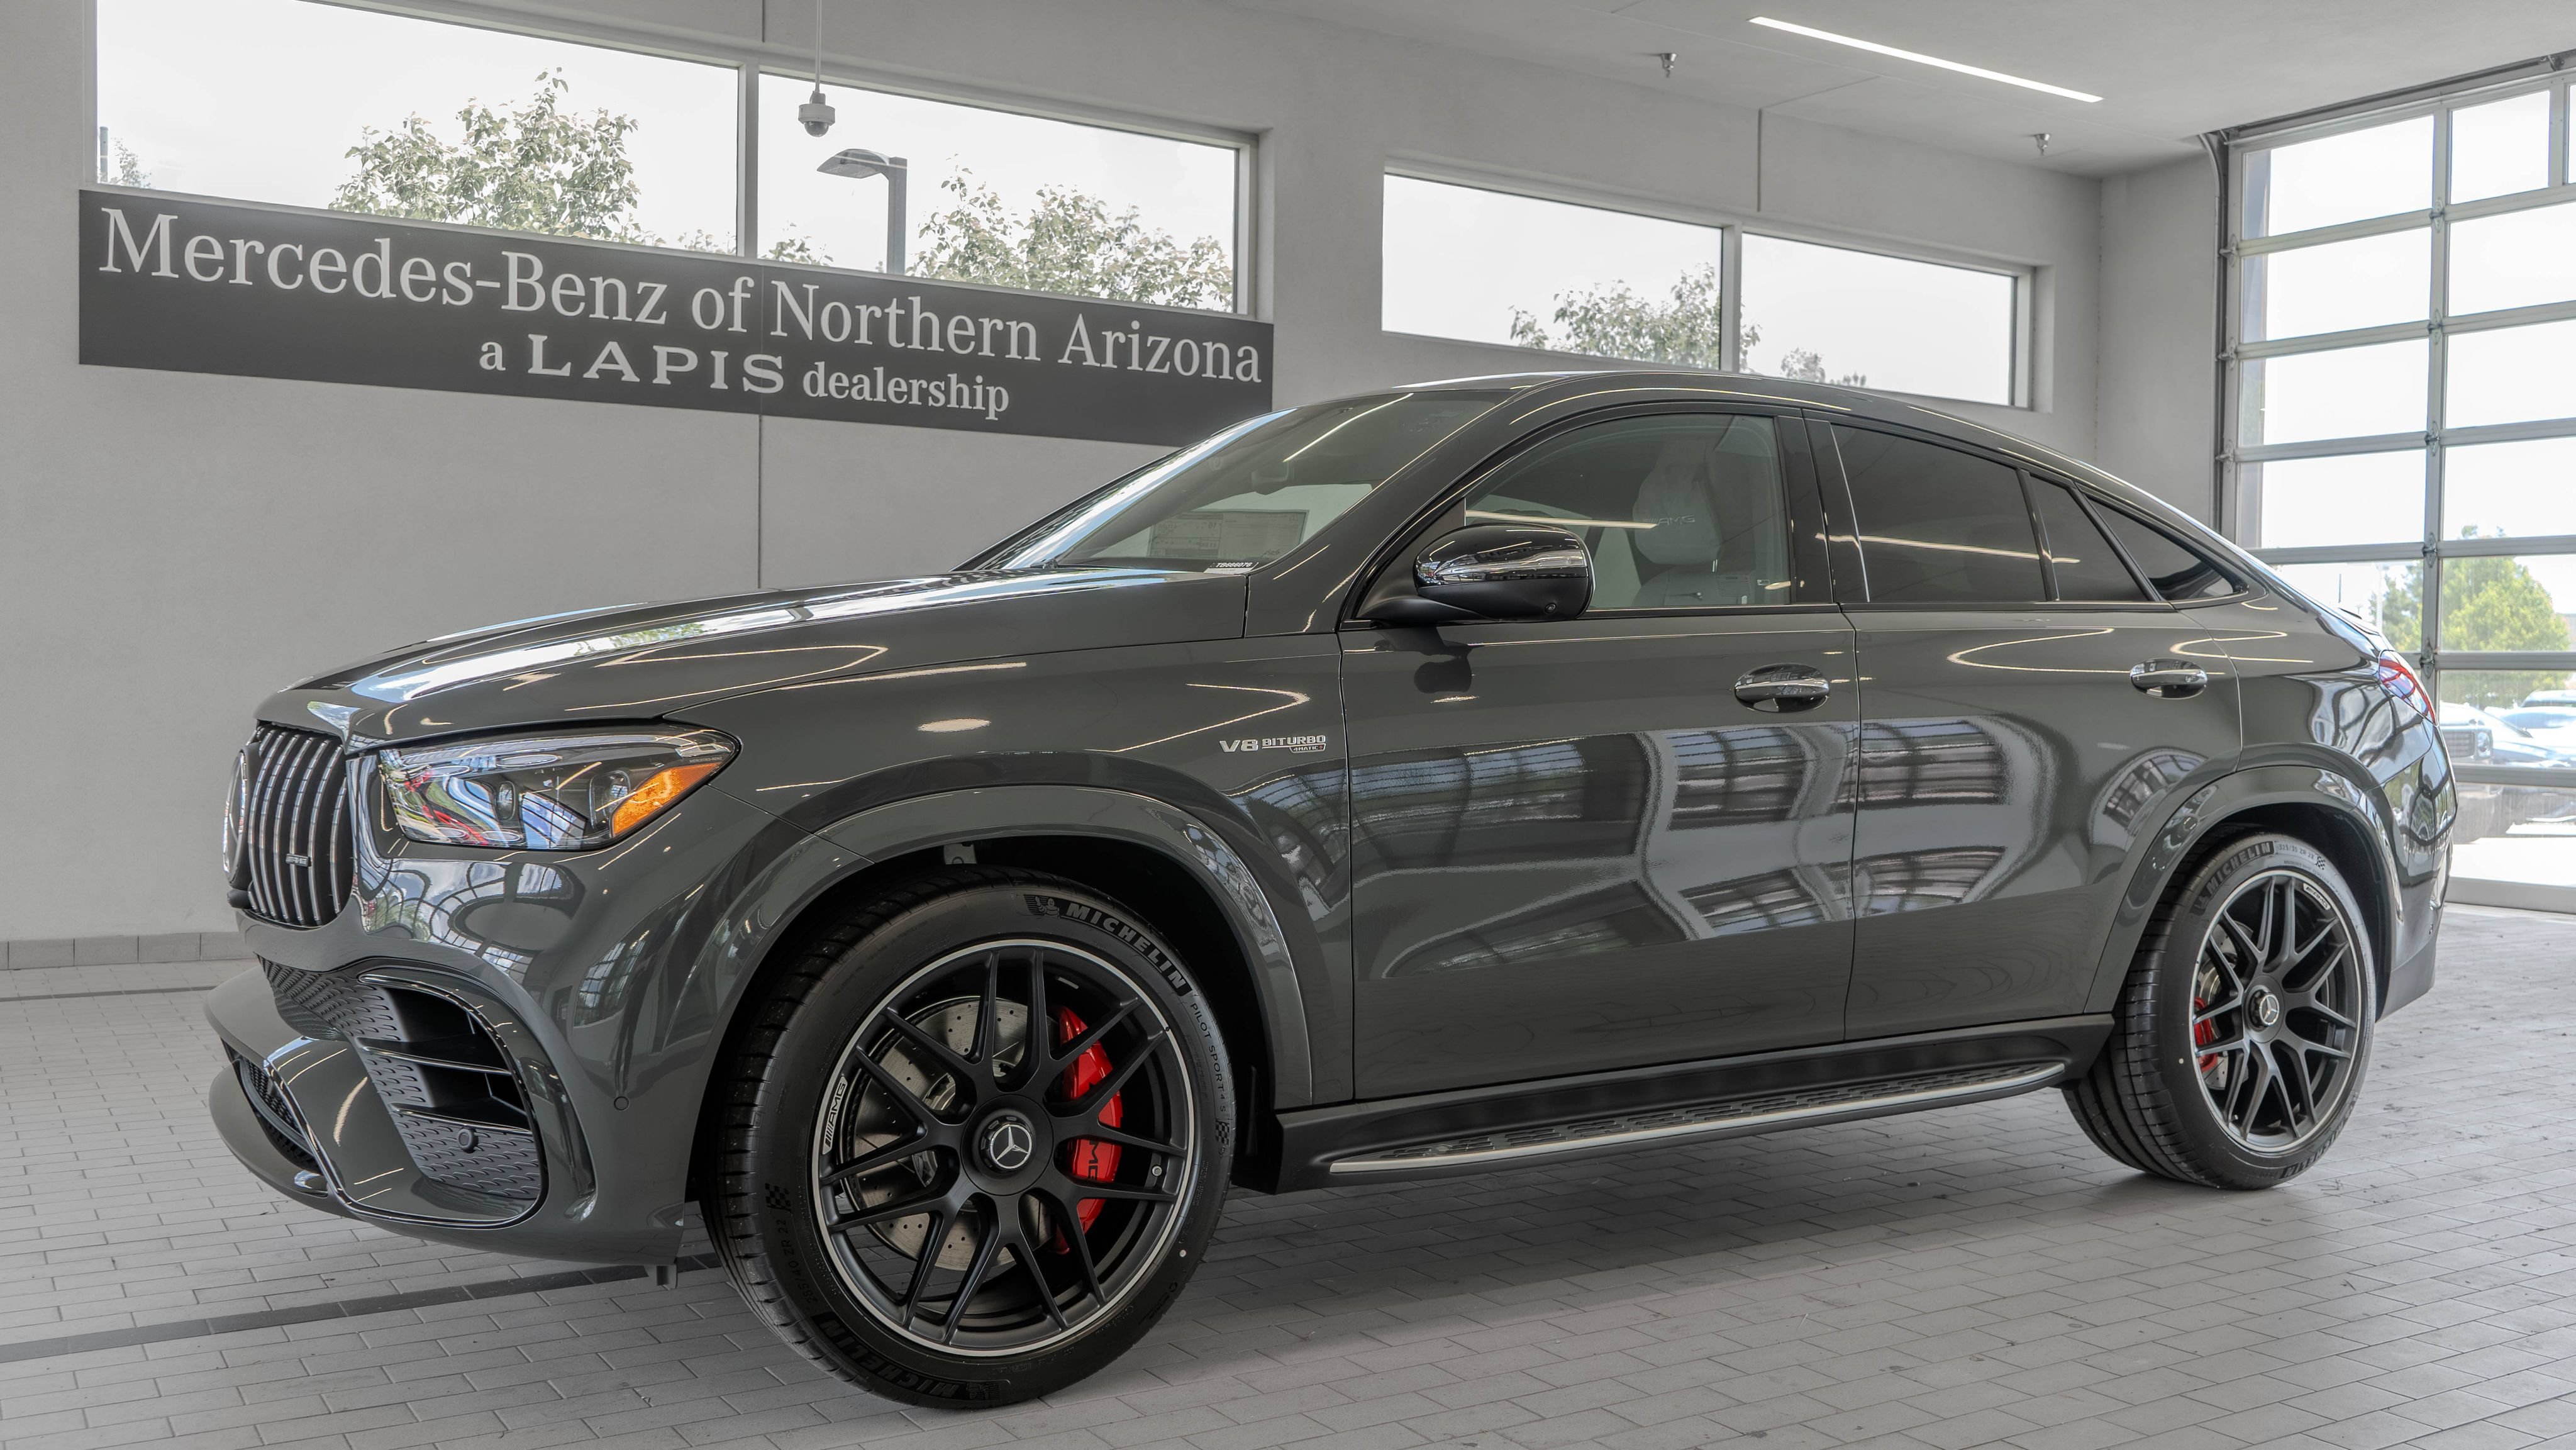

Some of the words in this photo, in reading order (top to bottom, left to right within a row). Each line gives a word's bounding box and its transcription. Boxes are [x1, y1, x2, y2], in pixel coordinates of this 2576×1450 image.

[99, 207, 668, 325] Mercedes-Benz
[692, 276, 754, 333] of
[770, 280, 1041, 362] Northern
[1057, 313, 1262, 383] Arizona
[479, 340, 506, 371] a
[528, 333, 784, 394] LAPIS
[802, 361, 1009, 420] dealership
[1219, 739, 1258, 753] V8
[1262, 735, 1326, 747] BITURBO
[2206, 842, 2272, 895] MICHELIN
[1065, 902, 1187, 990] MICHELIN
[1190, 1003, 1212, 1039] PILOT
[819, 1319, 960, 1399] MICHELIN
